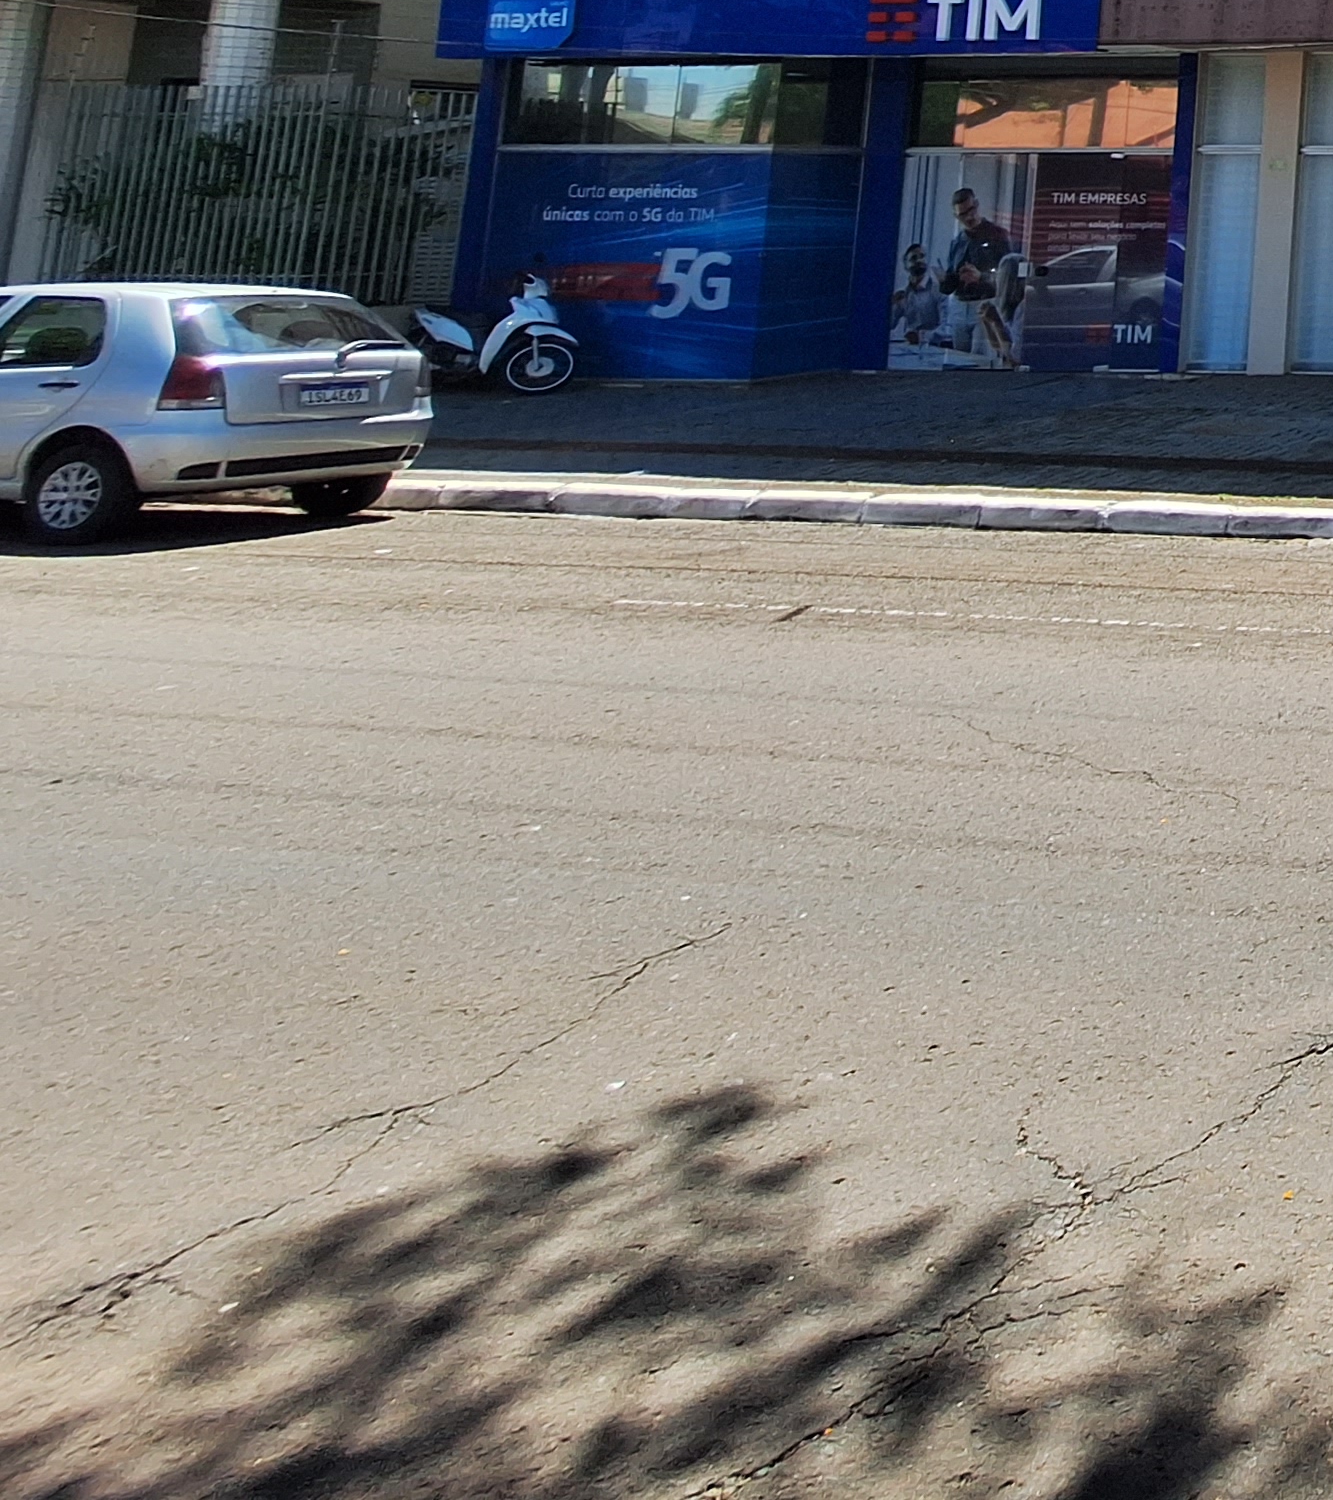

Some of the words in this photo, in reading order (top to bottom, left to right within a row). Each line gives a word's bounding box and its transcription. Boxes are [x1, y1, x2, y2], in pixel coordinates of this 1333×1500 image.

[490, 7, 568, 33] maxtel
[568, 183, 604, 198] Curta
[608, 183, 698, 201] experiências
[1051, 192, 1075, 204] TIM
[1080, 192, 1147, 205] EMPRESAS
[543, 206, 590, 222] únicas
[594, 210, 624, 222] com
[629, 211, 638, 222] o
[641, 207, 662, 222] 5G
[666, 207, 683, 222] da
[650, 247, 732, 319] 5G
[1113, 324, 1152, 344] TIM
